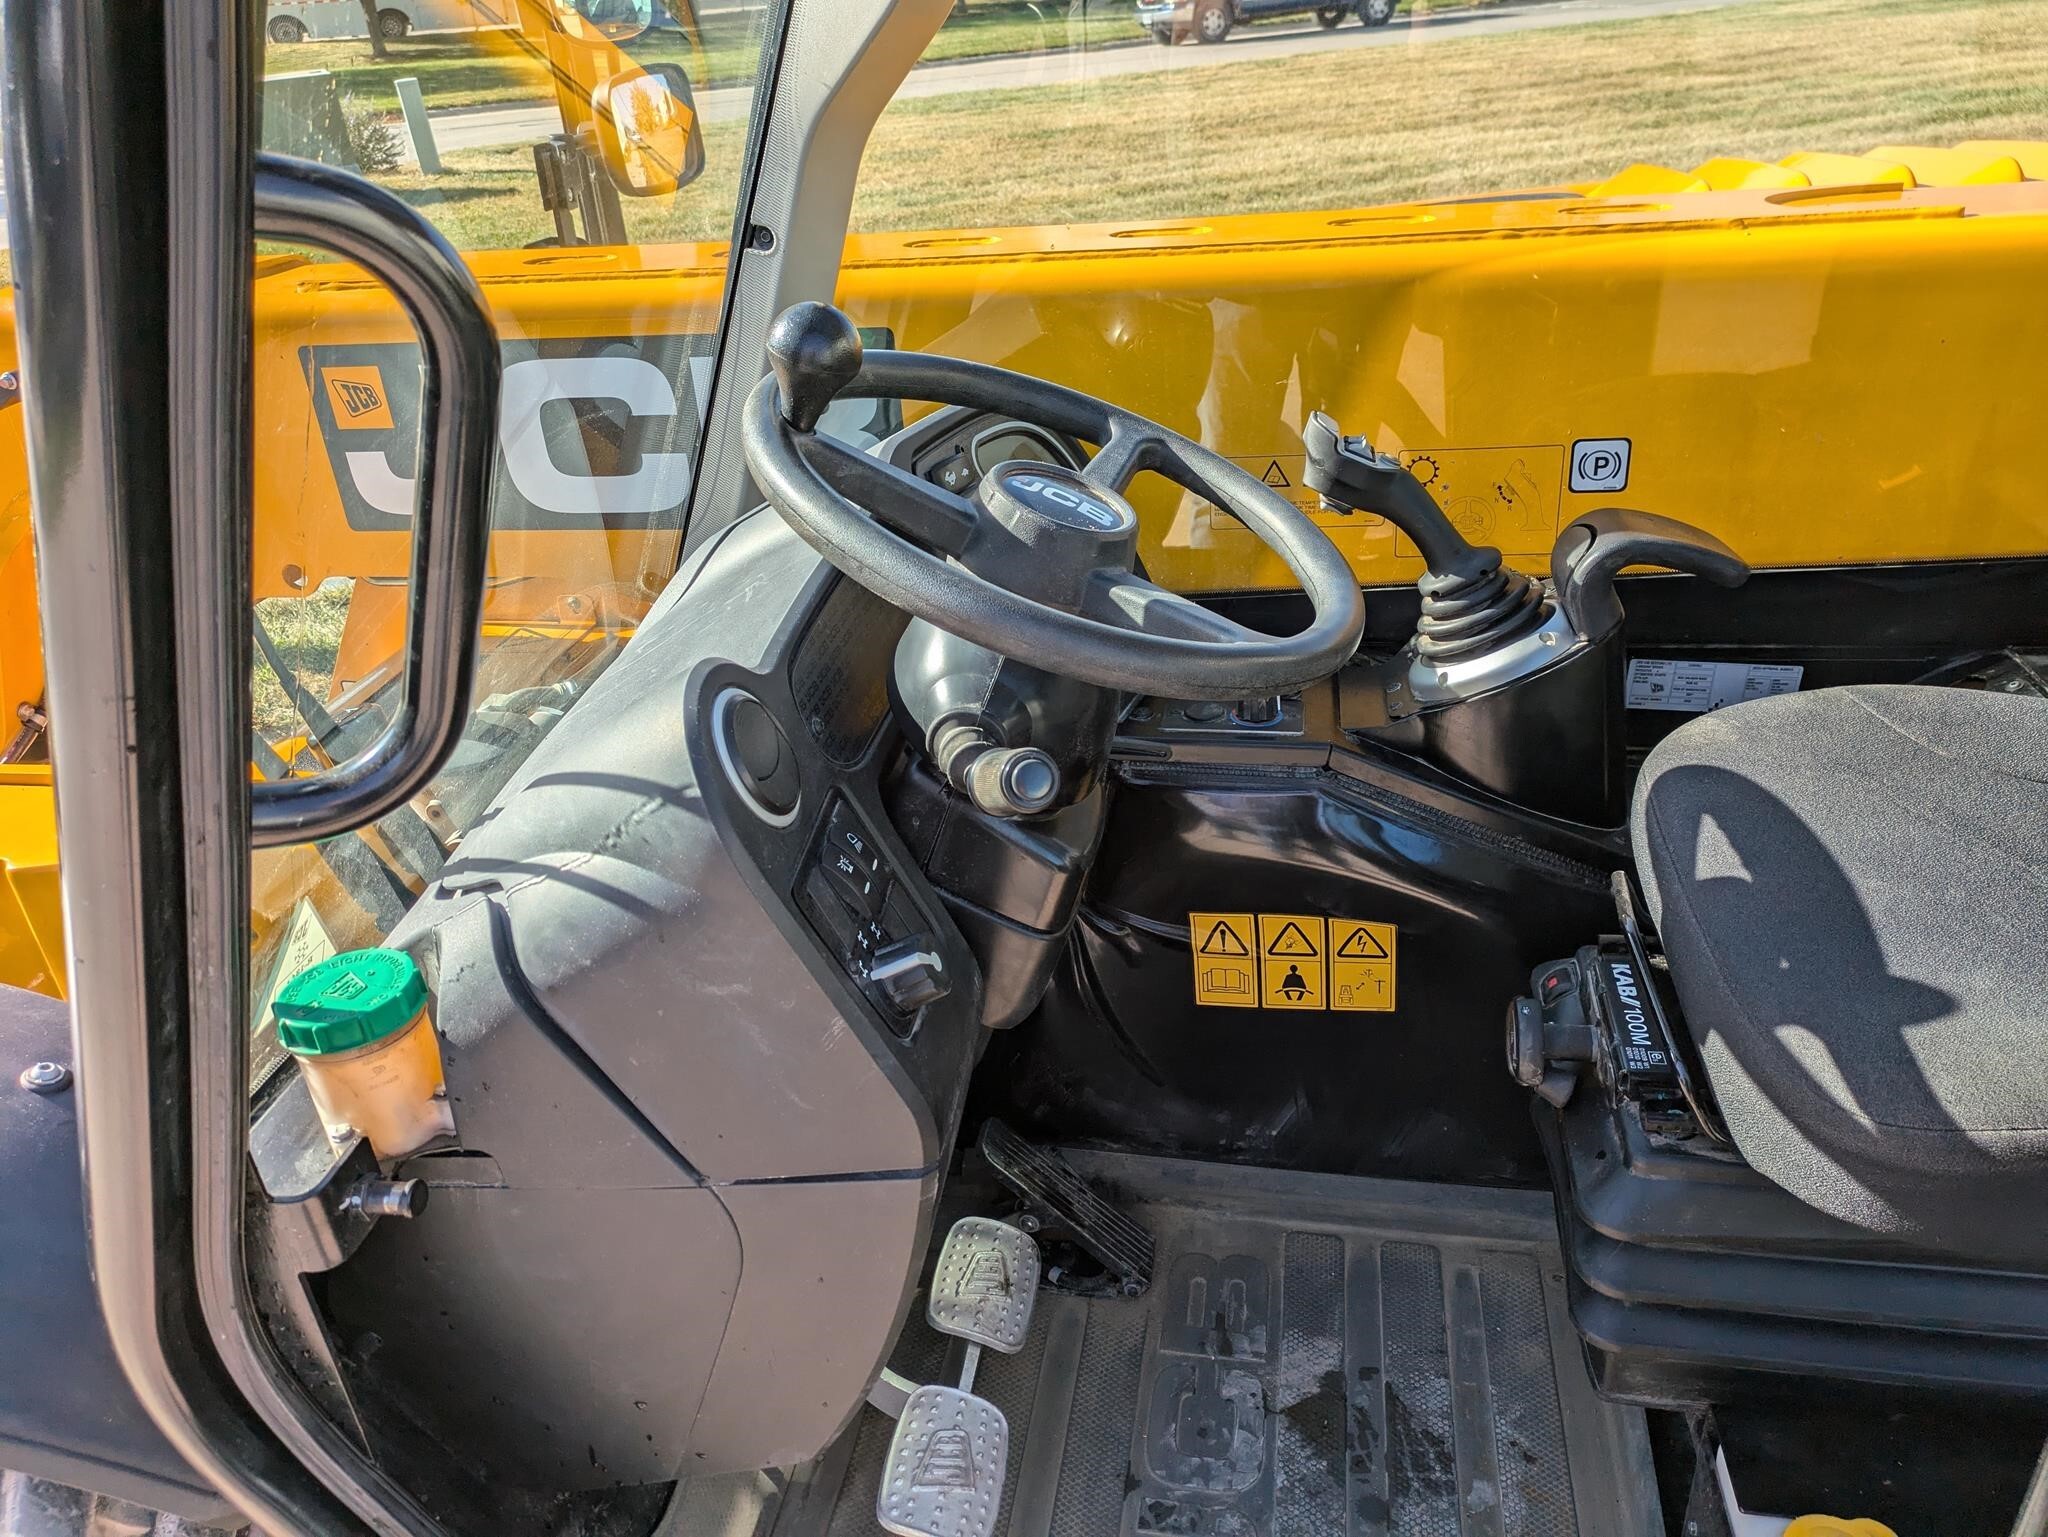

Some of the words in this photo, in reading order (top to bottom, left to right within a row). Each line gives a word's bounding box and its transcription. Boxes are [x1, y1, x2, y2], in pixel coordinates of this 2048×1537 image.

[340, 382, 379, 414] JCB
[1593, 456, 1610, 477] P
[1011, 477, 1114, 527] JCB
[330, 953, 370, 968] LIGHT
